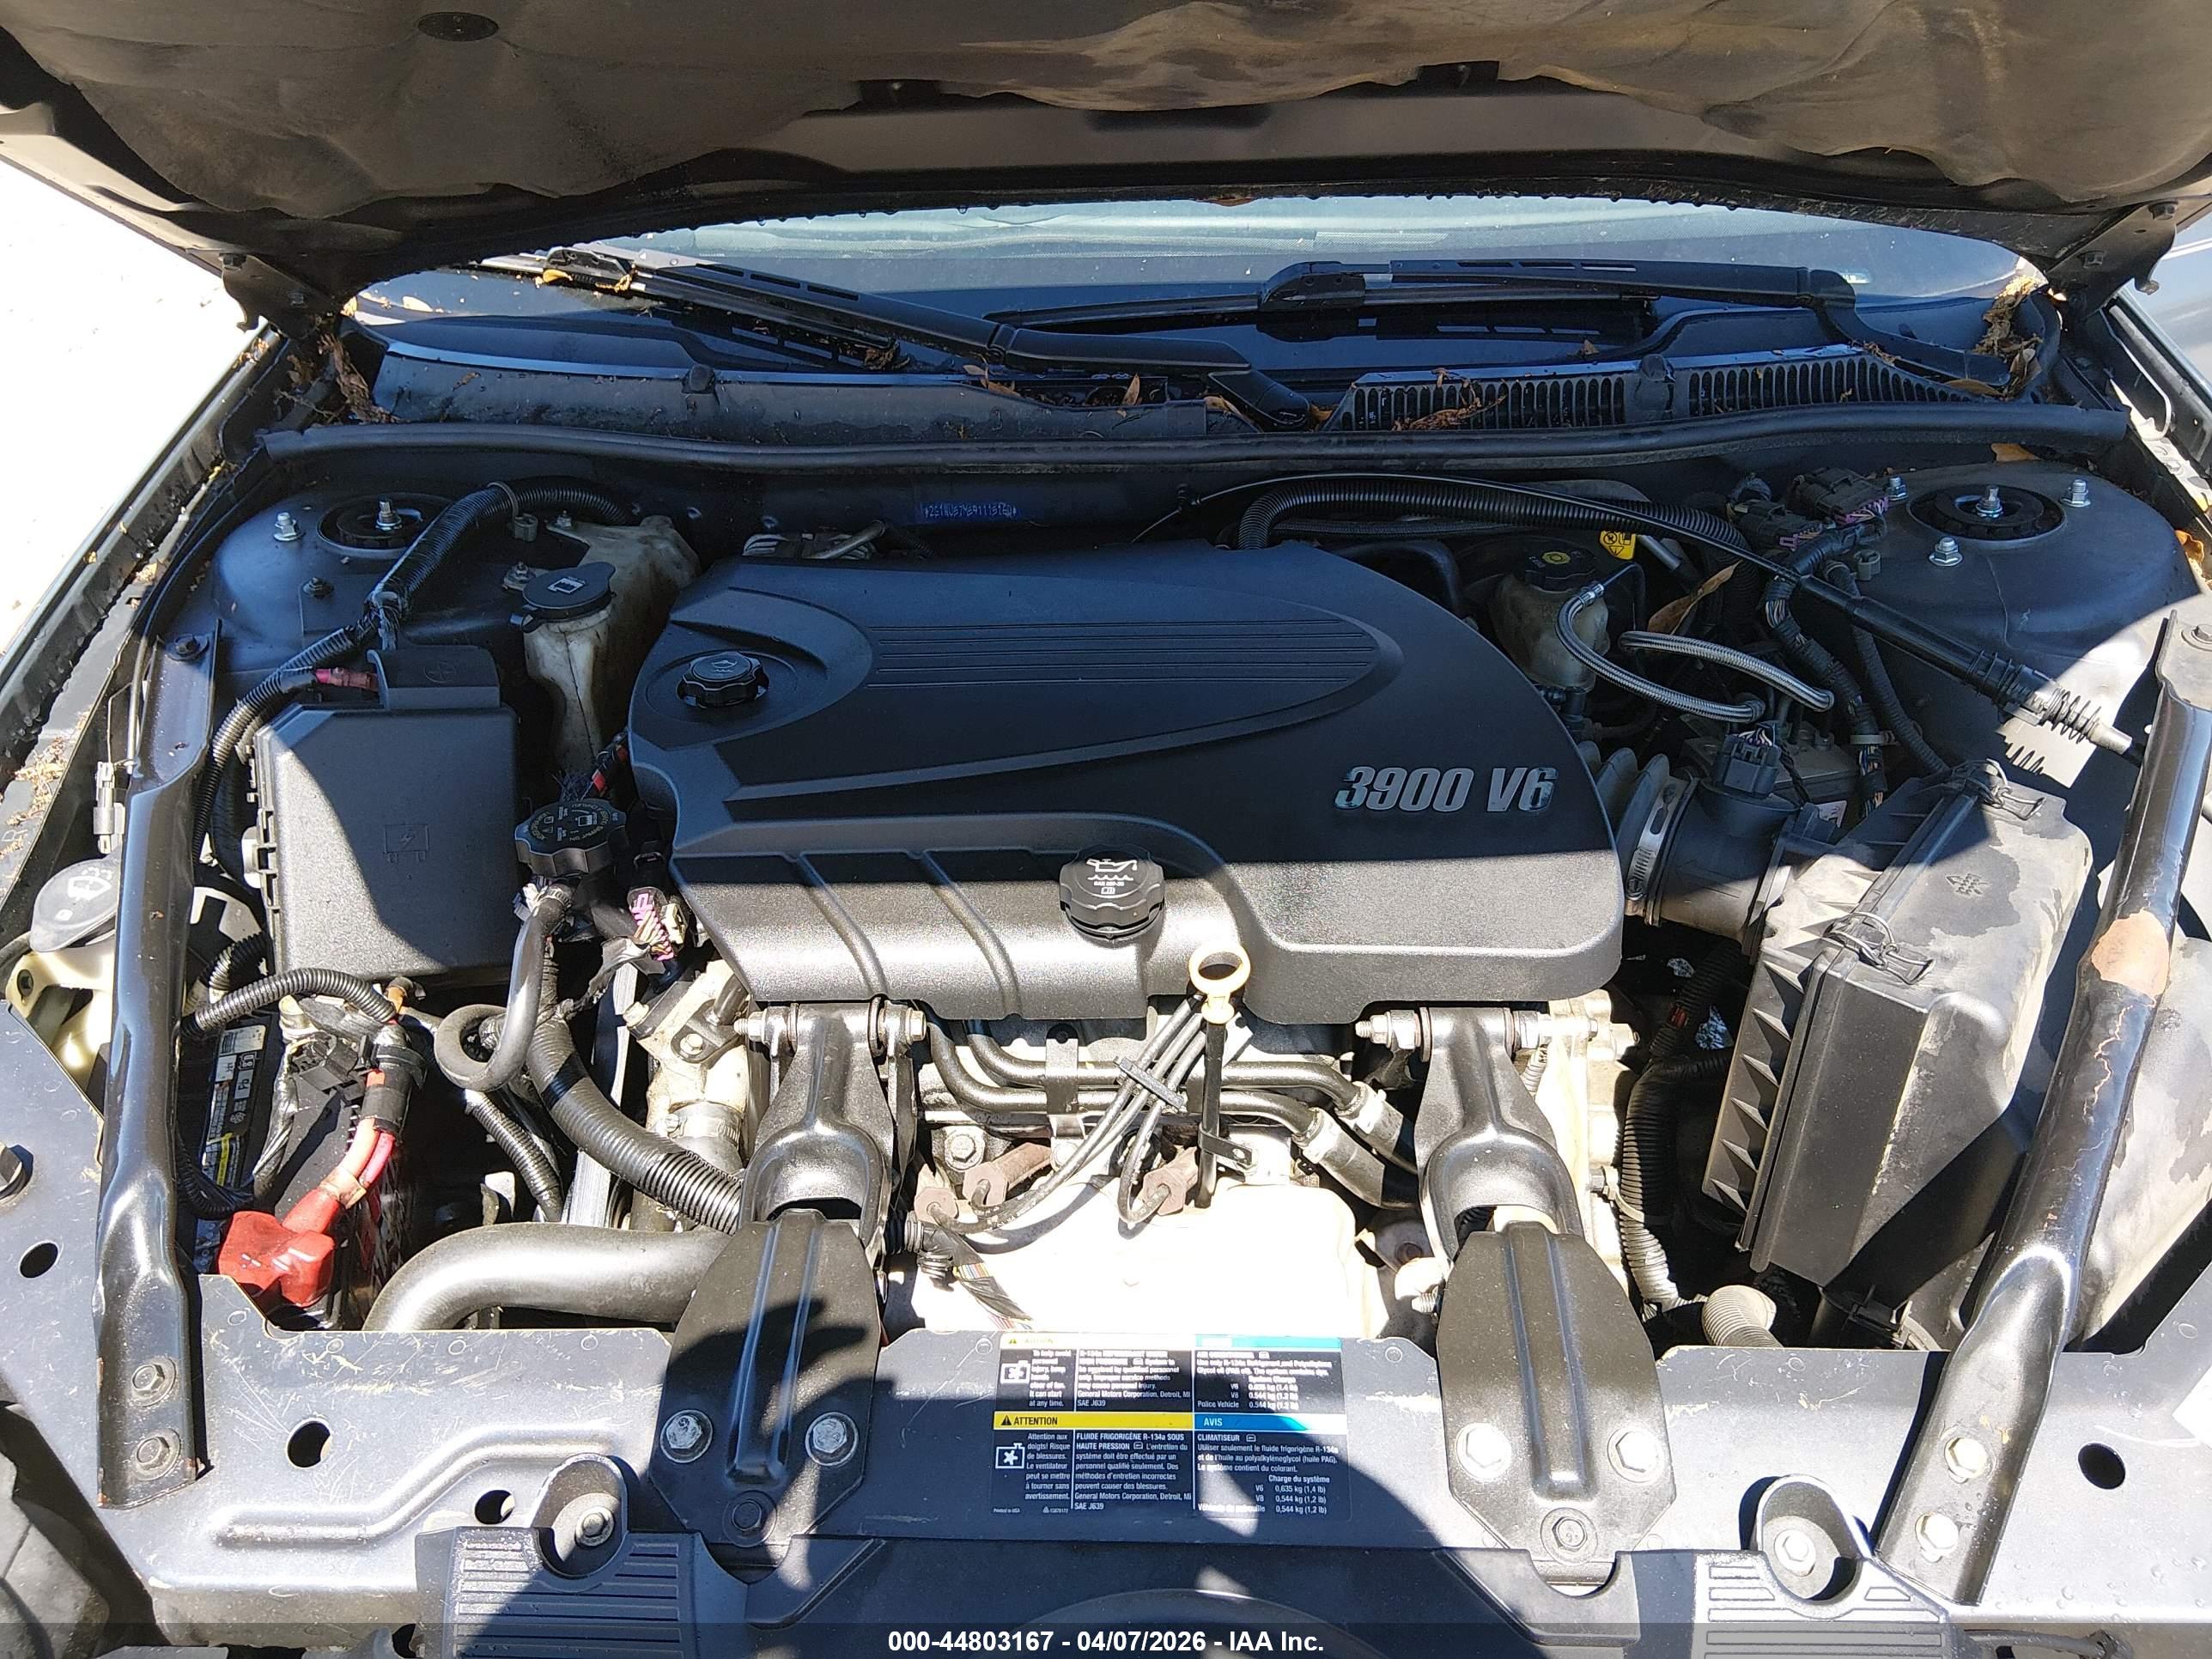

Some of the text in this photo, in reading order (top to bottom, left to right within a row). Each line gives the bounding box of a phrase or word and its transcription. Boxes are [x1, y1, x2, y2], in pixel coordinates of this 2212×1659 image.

[1334, 767, 1559, 811] 3900 V6
[238, 1079, 249, 1091] Pb
[1028, 1443, 1070, 1451] doigts! Risque
